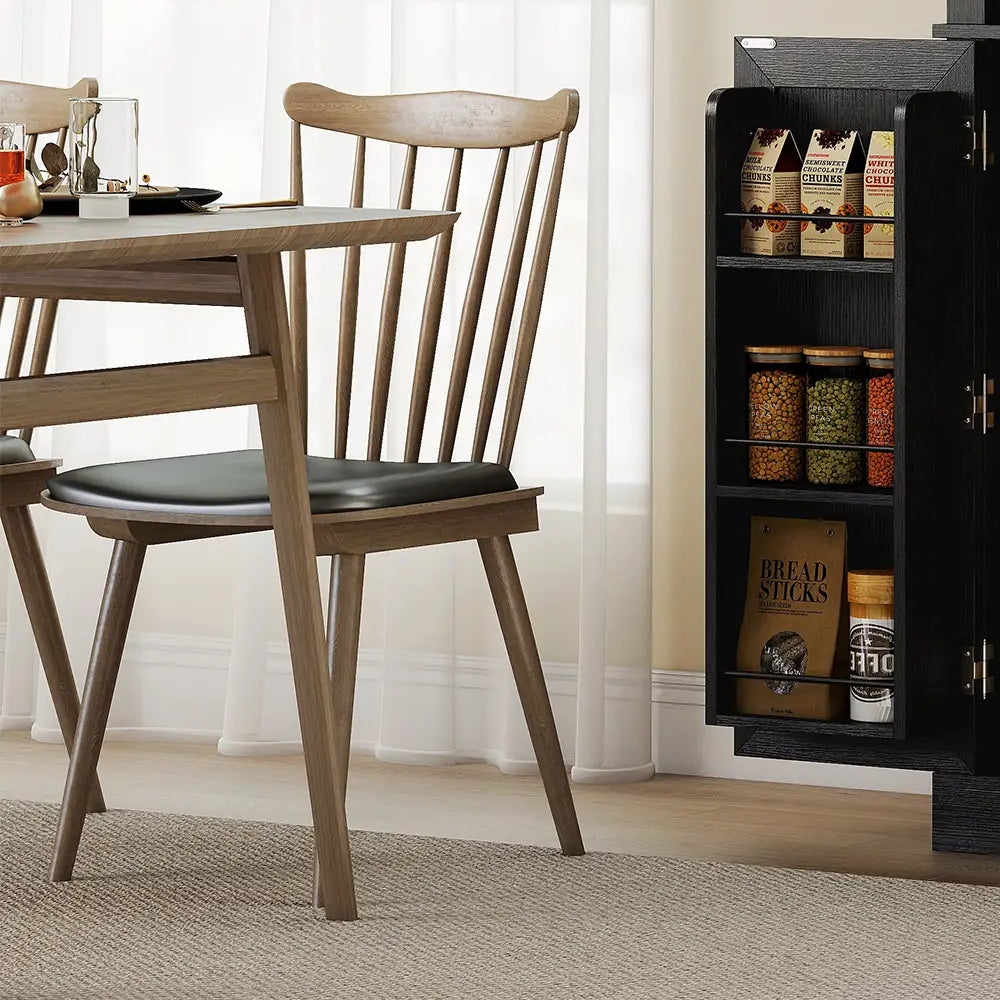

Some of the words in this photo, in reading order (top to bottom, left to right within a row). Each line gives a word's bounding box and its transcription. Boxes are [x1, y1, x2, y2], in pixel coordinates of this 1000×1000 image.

[746, 156, 763, 164] MILK
[804, 159, 846, 167] SEMISWEET
[802, 166, 845, 174] CHOCOLATE
[742, 171, 772, 182] CHUNKS
[802, 173, 843, 183] CHUNKS
[759, 558, 828, 583] BREAD
[758, 579, 829, 604] STICKS
